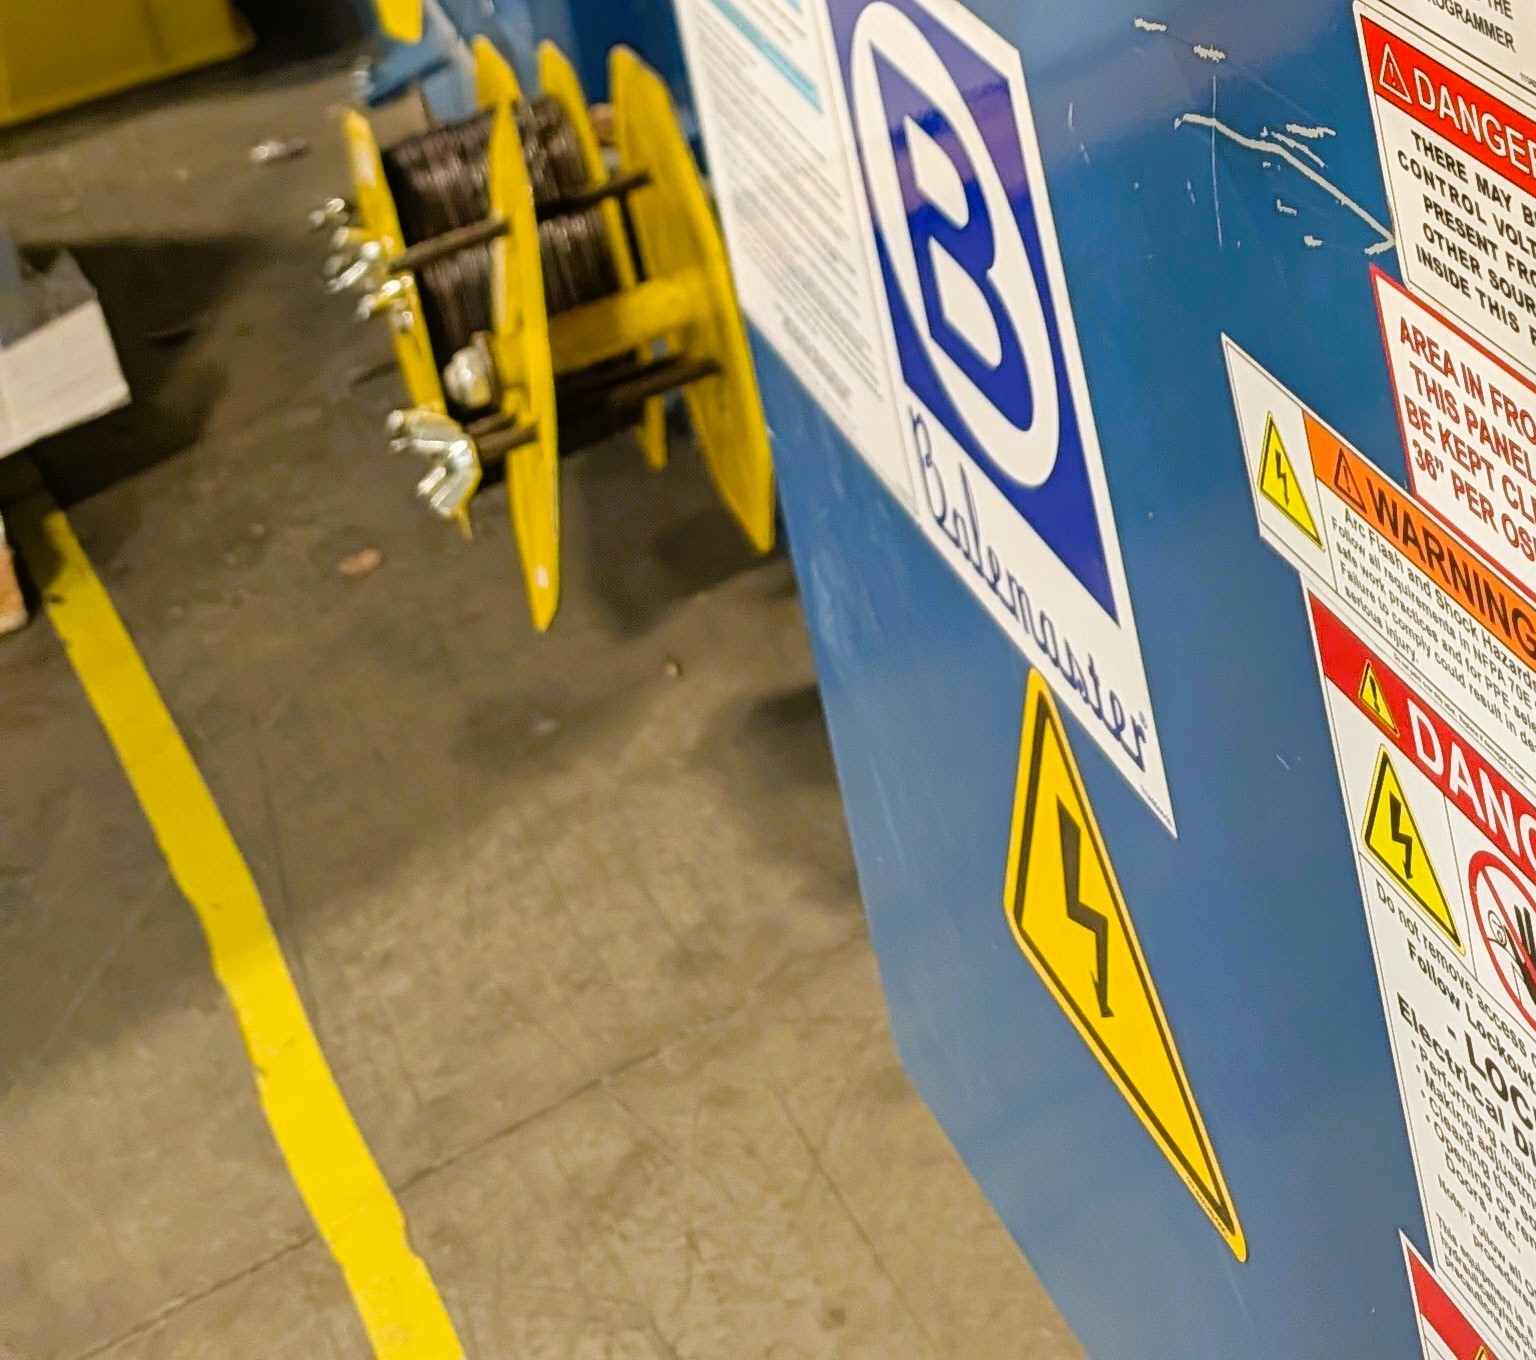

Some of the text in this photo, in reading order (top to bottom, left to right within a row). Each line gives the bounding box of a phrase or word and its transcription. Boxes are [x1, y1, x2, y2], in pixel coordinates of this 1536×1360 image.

[1397, 150, 1486, 224] CONTROL
[1410, 130, 1468, 183] THERE
[1474, 172, 1511, 211] MAY
[1422, 222, 1481, 278] OTHER
[1423, 194, 1497, 260] PRESENT
[1415, 244, 1470, 298] INSIDE
[1474, 286, 1519, 333] THIS
[1400, 317, 1459, 386] AREA
[1460, 362, 1485, 406] IN
[1409, 361, 1460, 424] THIS
[1403, 394, 1435, 443] BE
[1437, 421, 1494, 490] KEPT
[1450, 469, 1498, 532] PER
[908, 401, 1147, 774] Balemaster
[1331, 515, 1365, 557] Follow
[1368, 552, 1381, 571] all
[1383, 566, 1456, 639] requirements
[1458, 630, 1470, 653] in
[1472, 644, 1506, 686] NFPA
[1507, 676, 1532, 709] 70E
[1344, 507, 1365, 538] Arc
[1367, 527, 1403, 573] Flash
[1407, 567, 1432, 598] and
[1434, 588, 1478, 641] Shock
[1335, 541, 1357, 568] safe
[1359, 563, 1386, 595] work
[1388, 589, 1438, 642] practices
[1441, 638, 1462, 665] and
[1464, 657, 1481, 682] for
[1484, 674, 1510, 709] PPE
[1339, 560, 1375, 603] Failure
[1377, 596, 1389, 615] to
[1391, 611, 1430, 658] comply
[1434, 651, 1466, 688] could
[1468, 683, 1503, 722] result
[1504, 713, 1517, 736] in
[1344, 585, 1418, 662] serious injury.
[1375, 878, 1395, 913] Do
[1397, 907, 1420, 942] not
[1422, 934, 1473, 998] remove
[1476, 993, 1527, 1057] access
[1406, 938, 1460, 1010] Follow
[1396, 992, 1505, 1131] Electrical
[1418, 1044, 1497, 1148] Performing
[1423, 1069, 1474, 1142] Making
[1428, 1096, 1490, 1180] Cleaning
[1492, 1170, 1516, 1207] the
[1433, 1121, 1492, 1203] Opening
[1495, 1196, 1510, 1219] or
[1437, 1174, 1466, 1217] Note:
[1468, 1211, 1505, 1263] Follow
[1508, 1261, 1522, 1284] all
[1444, 1151, 1520, 1252] Doors, etc.
[1435, 1212, 1513, 1314] This equipment
[1444, 1253, 1502, 1329] precautions
